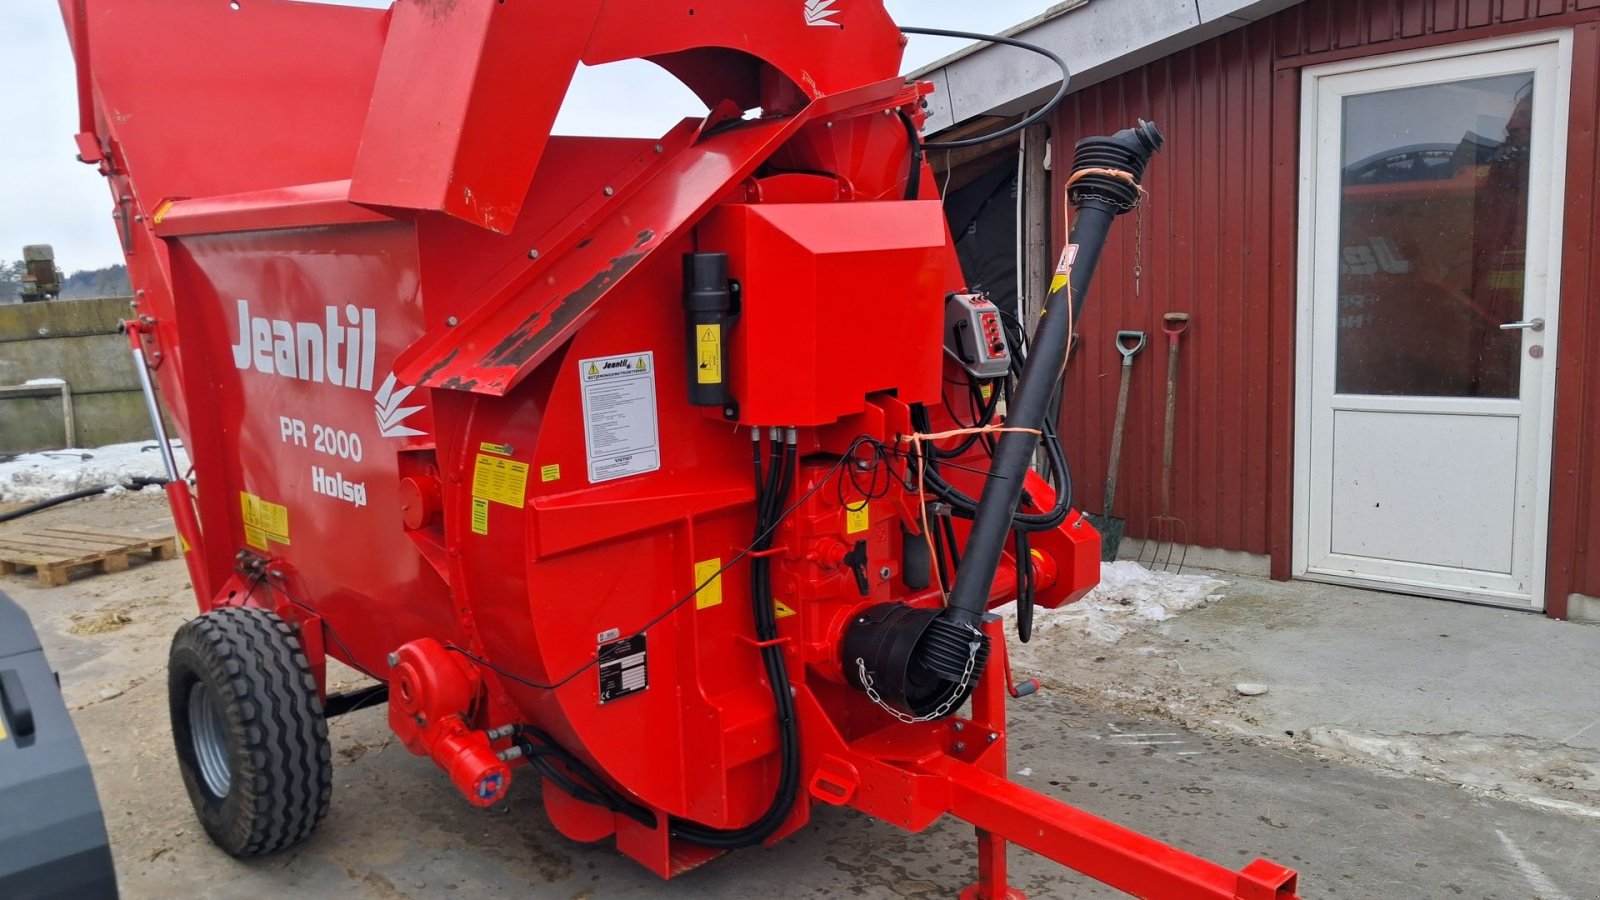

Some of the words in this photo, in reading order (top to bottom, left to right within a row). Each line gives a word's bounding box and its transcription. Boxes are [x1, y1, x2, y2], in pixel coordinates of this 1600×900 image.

[232, 299, 376, 391] Jeantil
[603, 359, 628, 369] Jeantil
[279, 416, 307, 448] PR
[312, 424, 362, 463] 2000
[311, 466, 367, 507] Holsø
